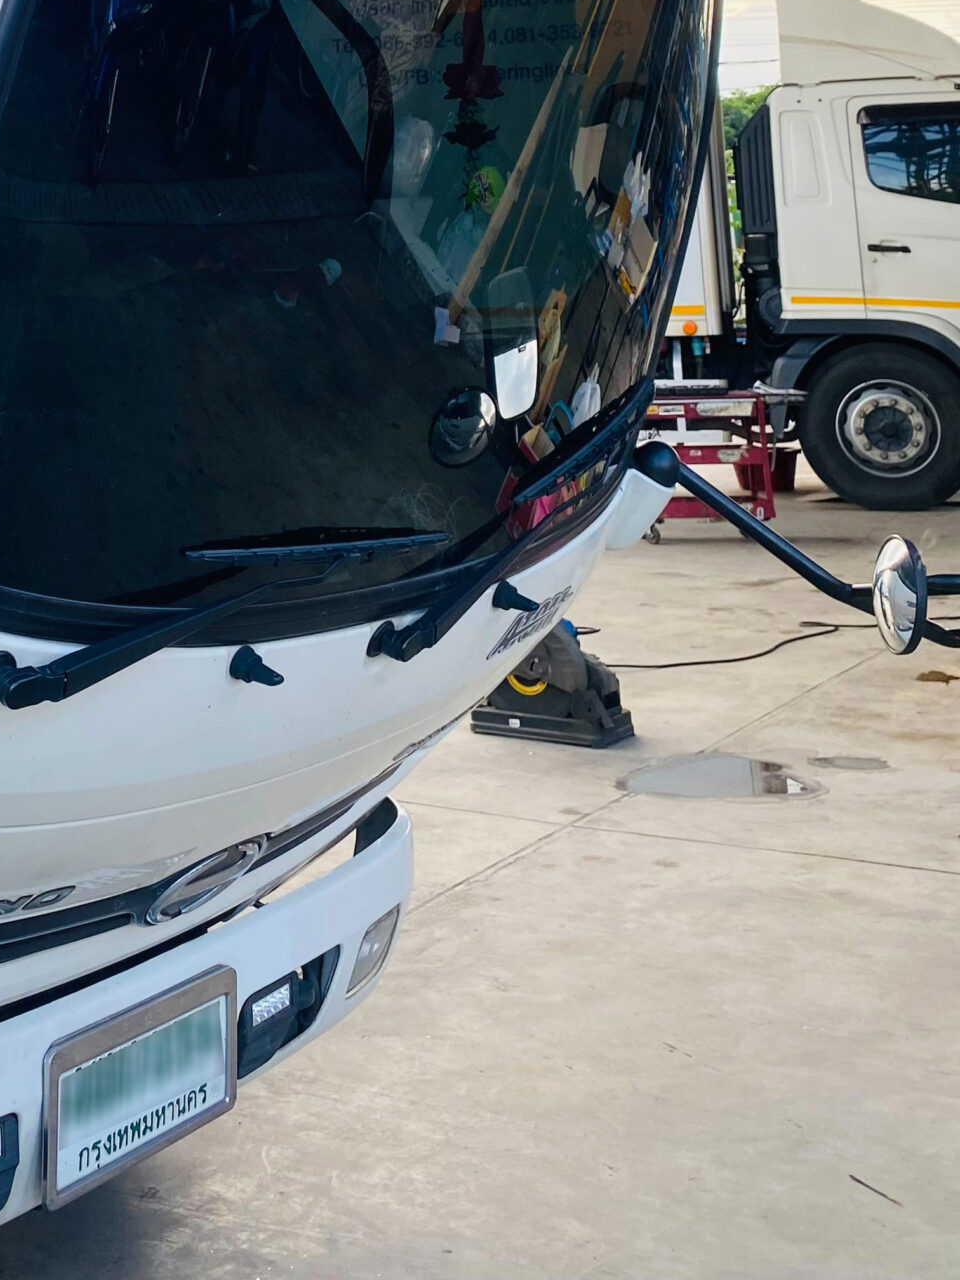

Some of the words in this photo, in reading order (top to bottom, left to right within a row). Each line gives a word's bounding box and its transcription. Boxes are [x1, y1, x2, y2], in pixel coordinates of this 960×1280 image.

[77, 1082, 208, 1171] กรุงเทพมหานคร
